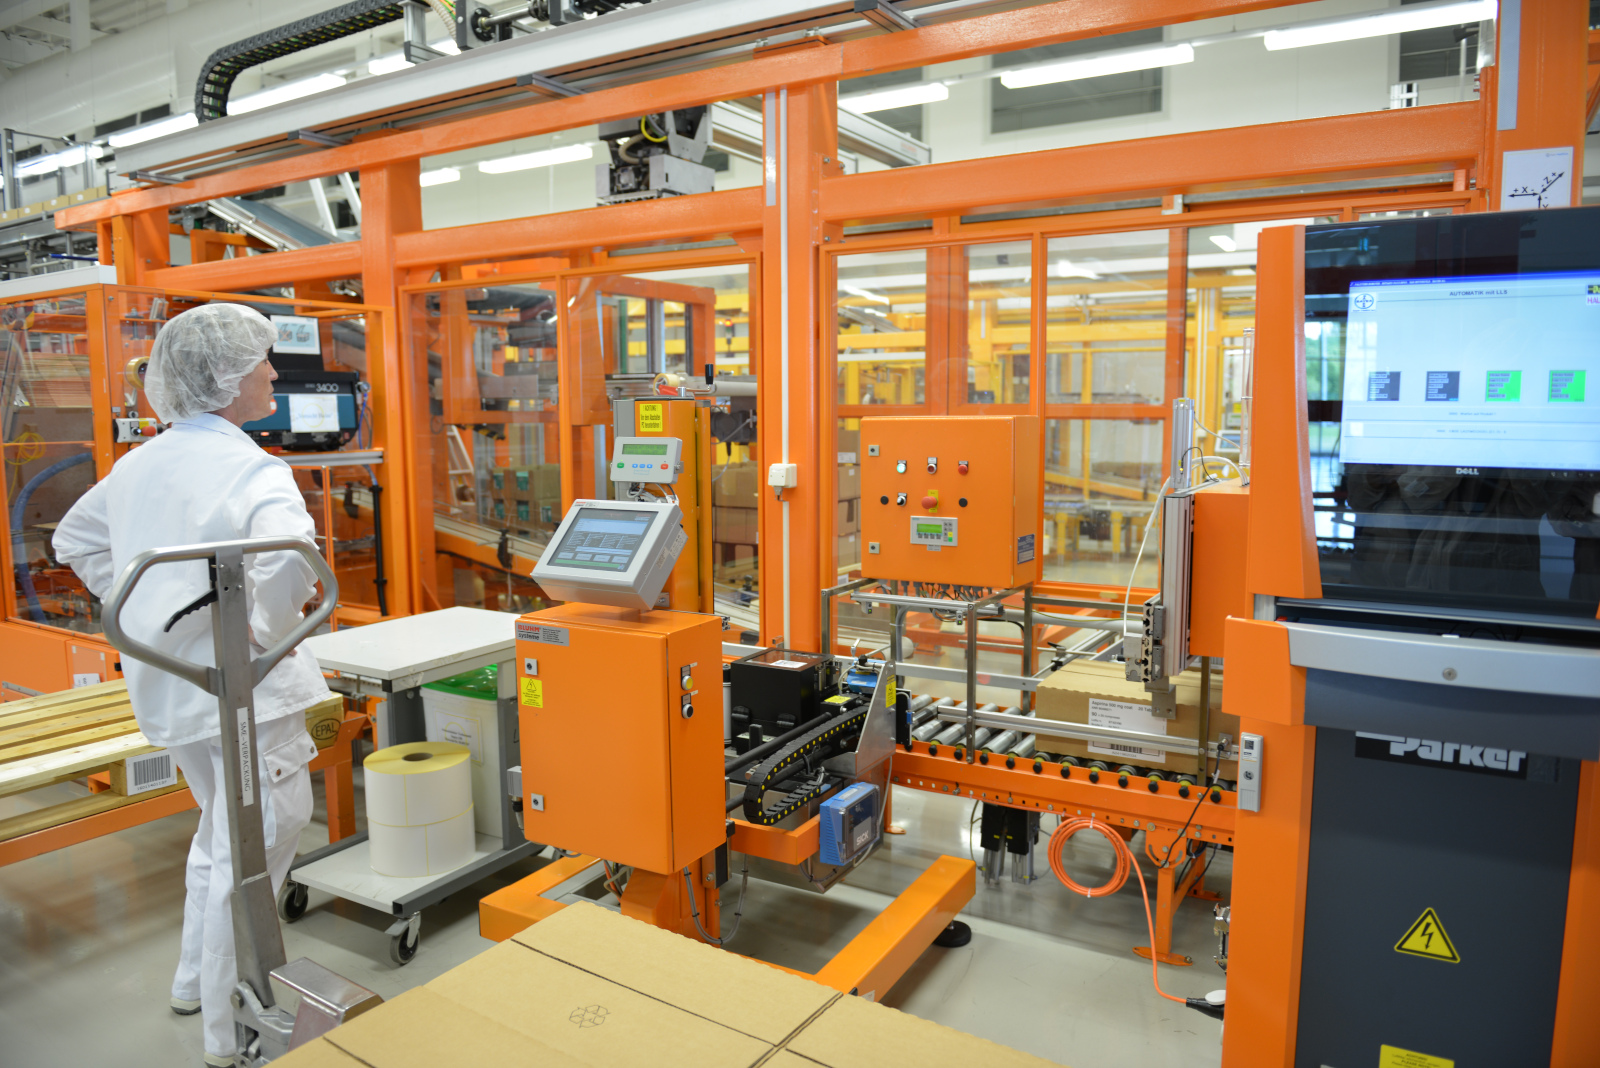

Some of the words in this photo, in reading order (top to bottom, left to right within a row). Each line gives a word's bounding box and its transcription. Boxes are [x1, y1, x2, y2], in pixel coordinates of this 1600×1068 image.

[316, 383, 339, 392] 3400
[315, 725, 338, 737] EPAL
[1390, 737, 1527, 772] Parker
[856, 830, 869, 845] SICK
